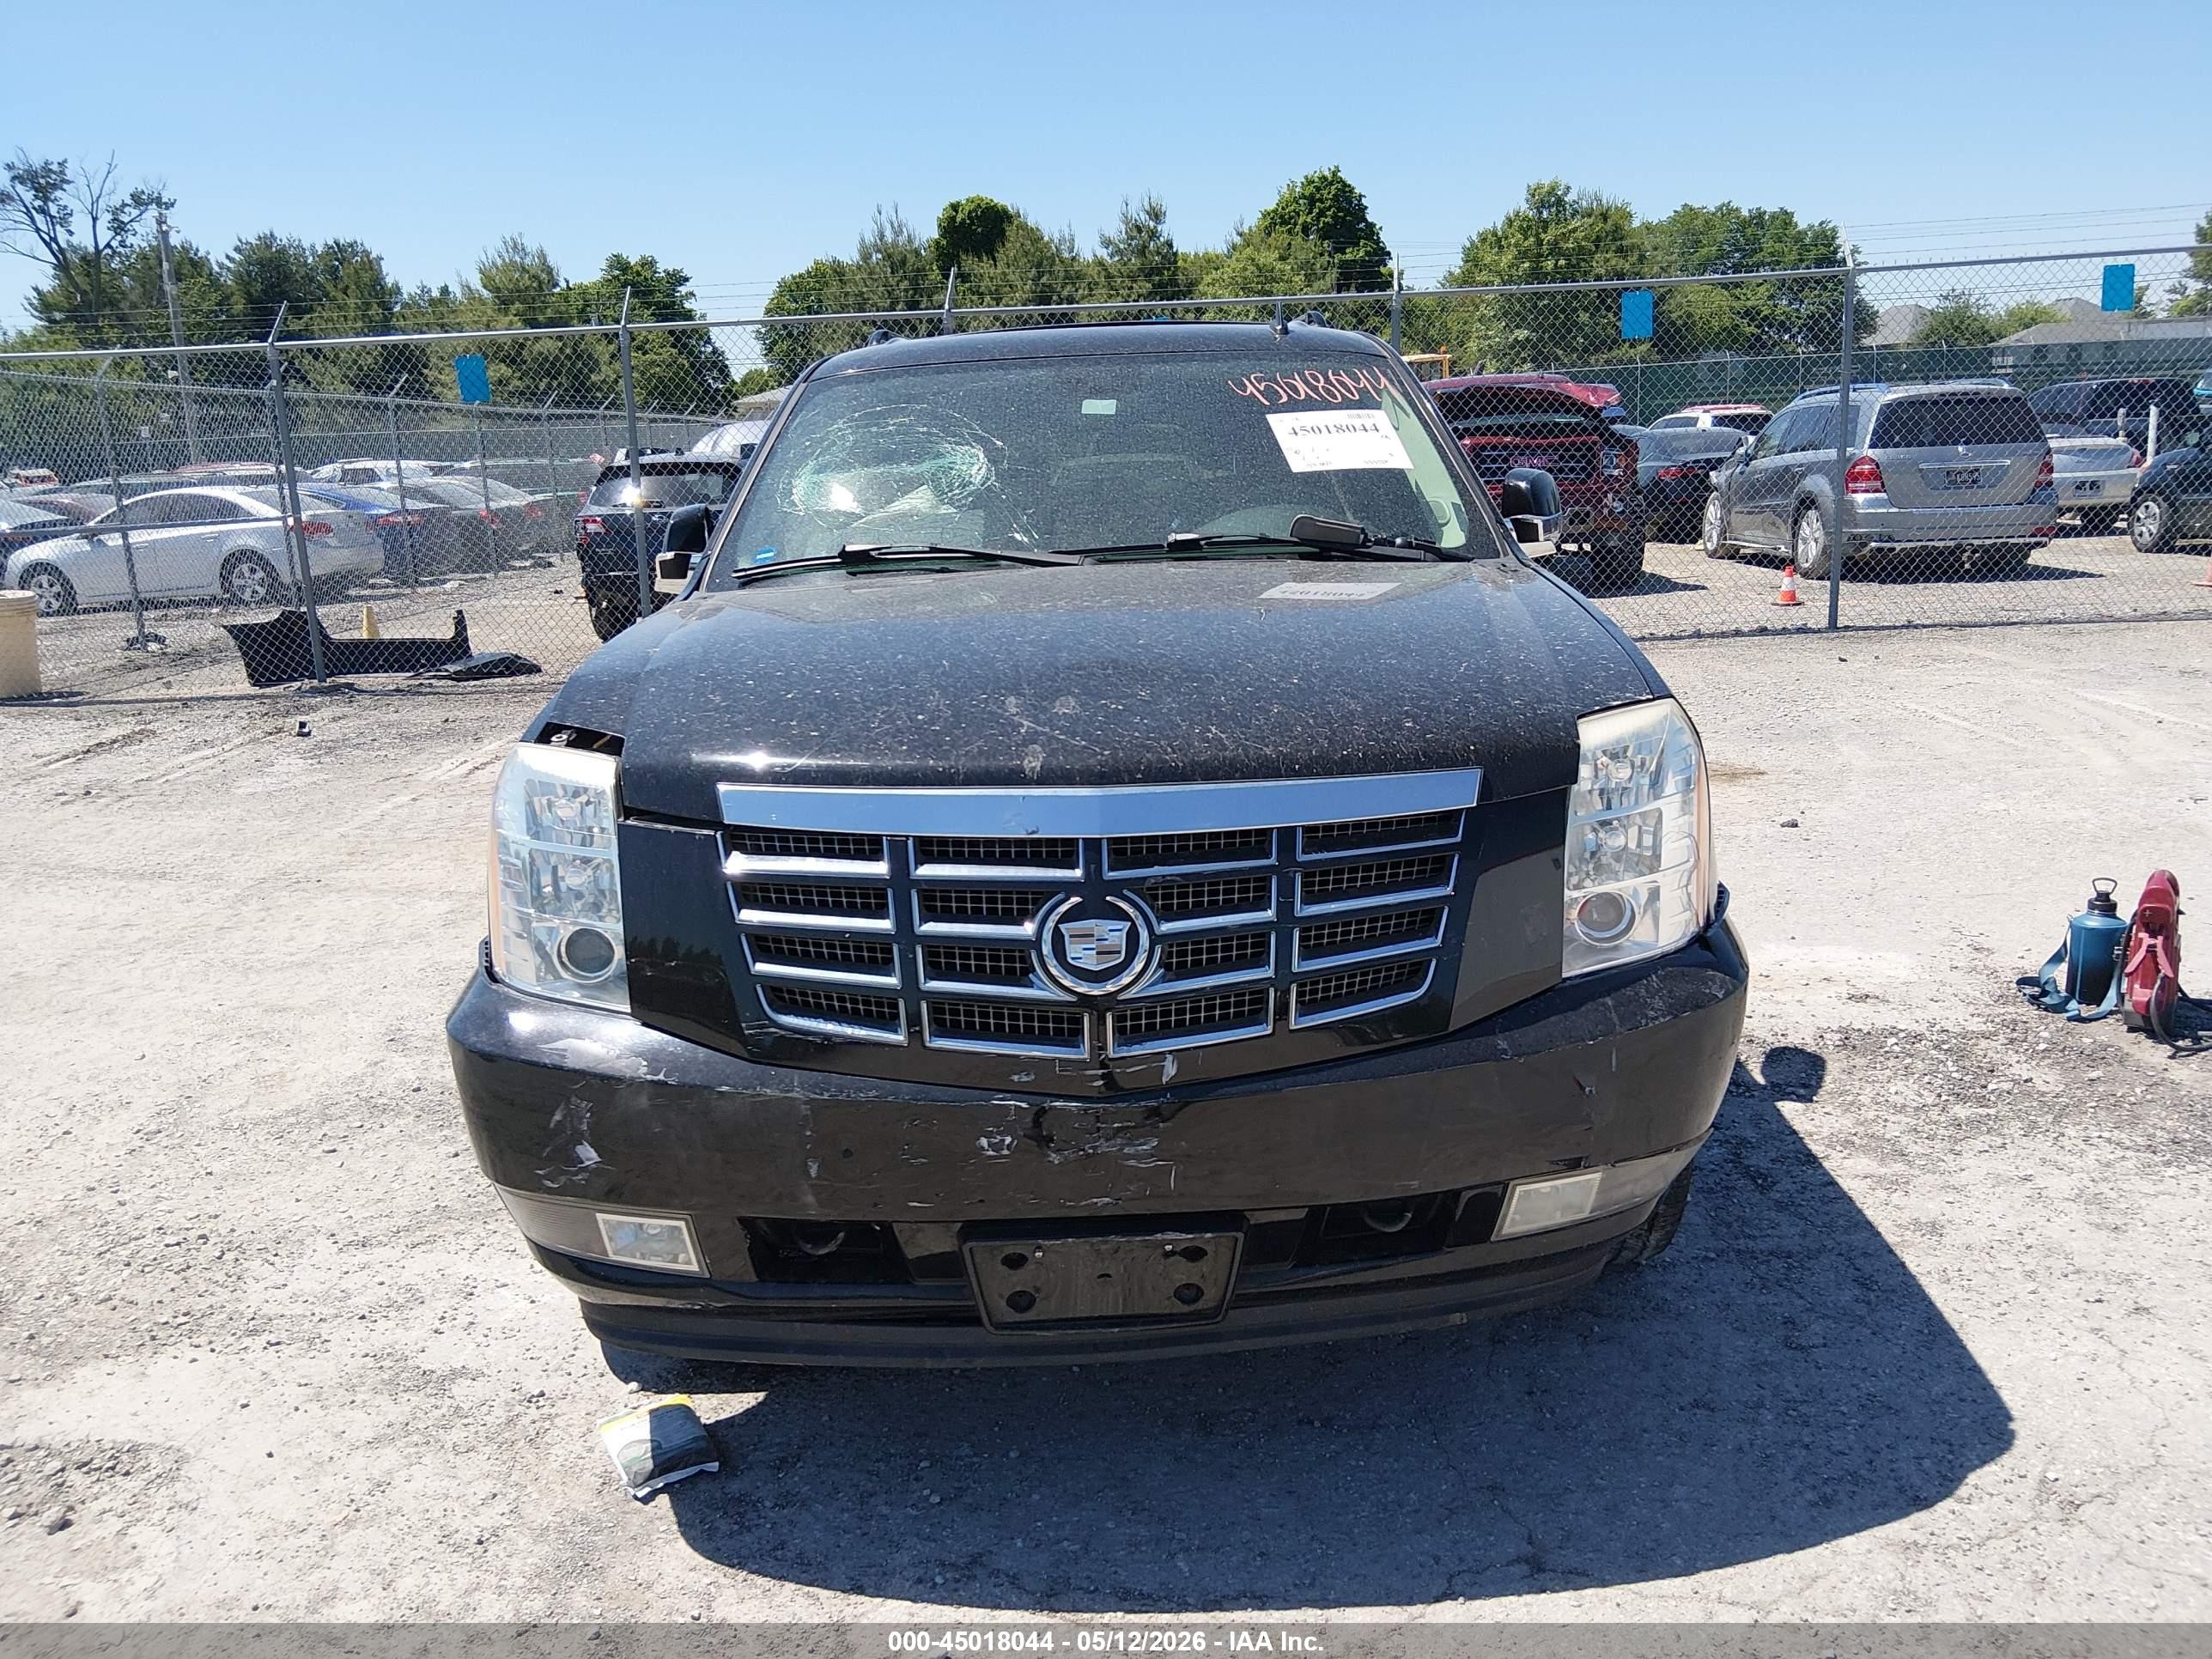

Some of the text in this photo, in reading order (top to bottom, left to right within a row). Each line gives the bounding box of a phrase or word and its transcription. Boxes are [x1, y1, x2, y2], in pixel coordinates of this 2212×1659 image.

[1228, 366, 1401, 405] 45018044
[1288, 423, 1381, 436] 45018044
[1510, 456, 1559, 467] GMC
